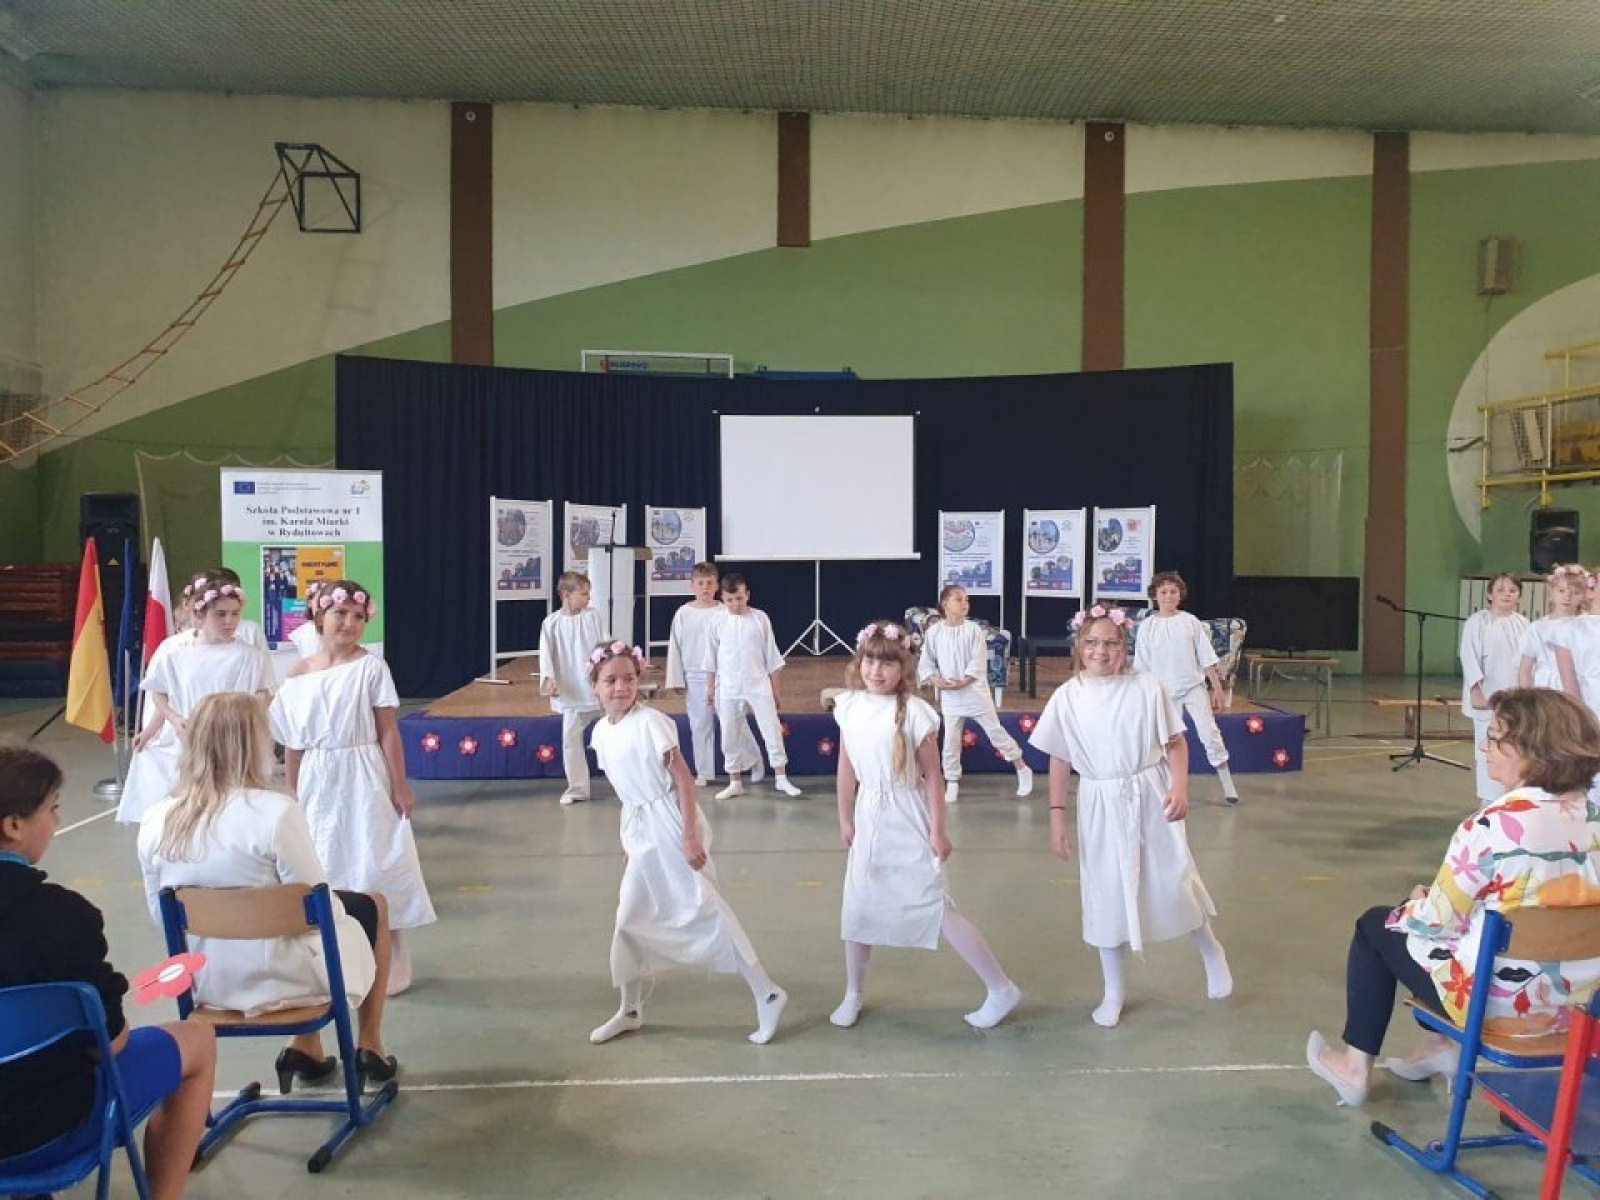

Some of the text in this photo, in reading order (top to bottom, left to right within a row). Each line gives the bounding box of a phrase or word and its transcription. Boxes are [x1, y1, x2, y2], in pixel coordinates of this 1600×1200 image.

[281, 505, 339, 514] Podstawowa
[281, 517, 314, 526] Karola
[316, 517, 349, 526] Miarki
